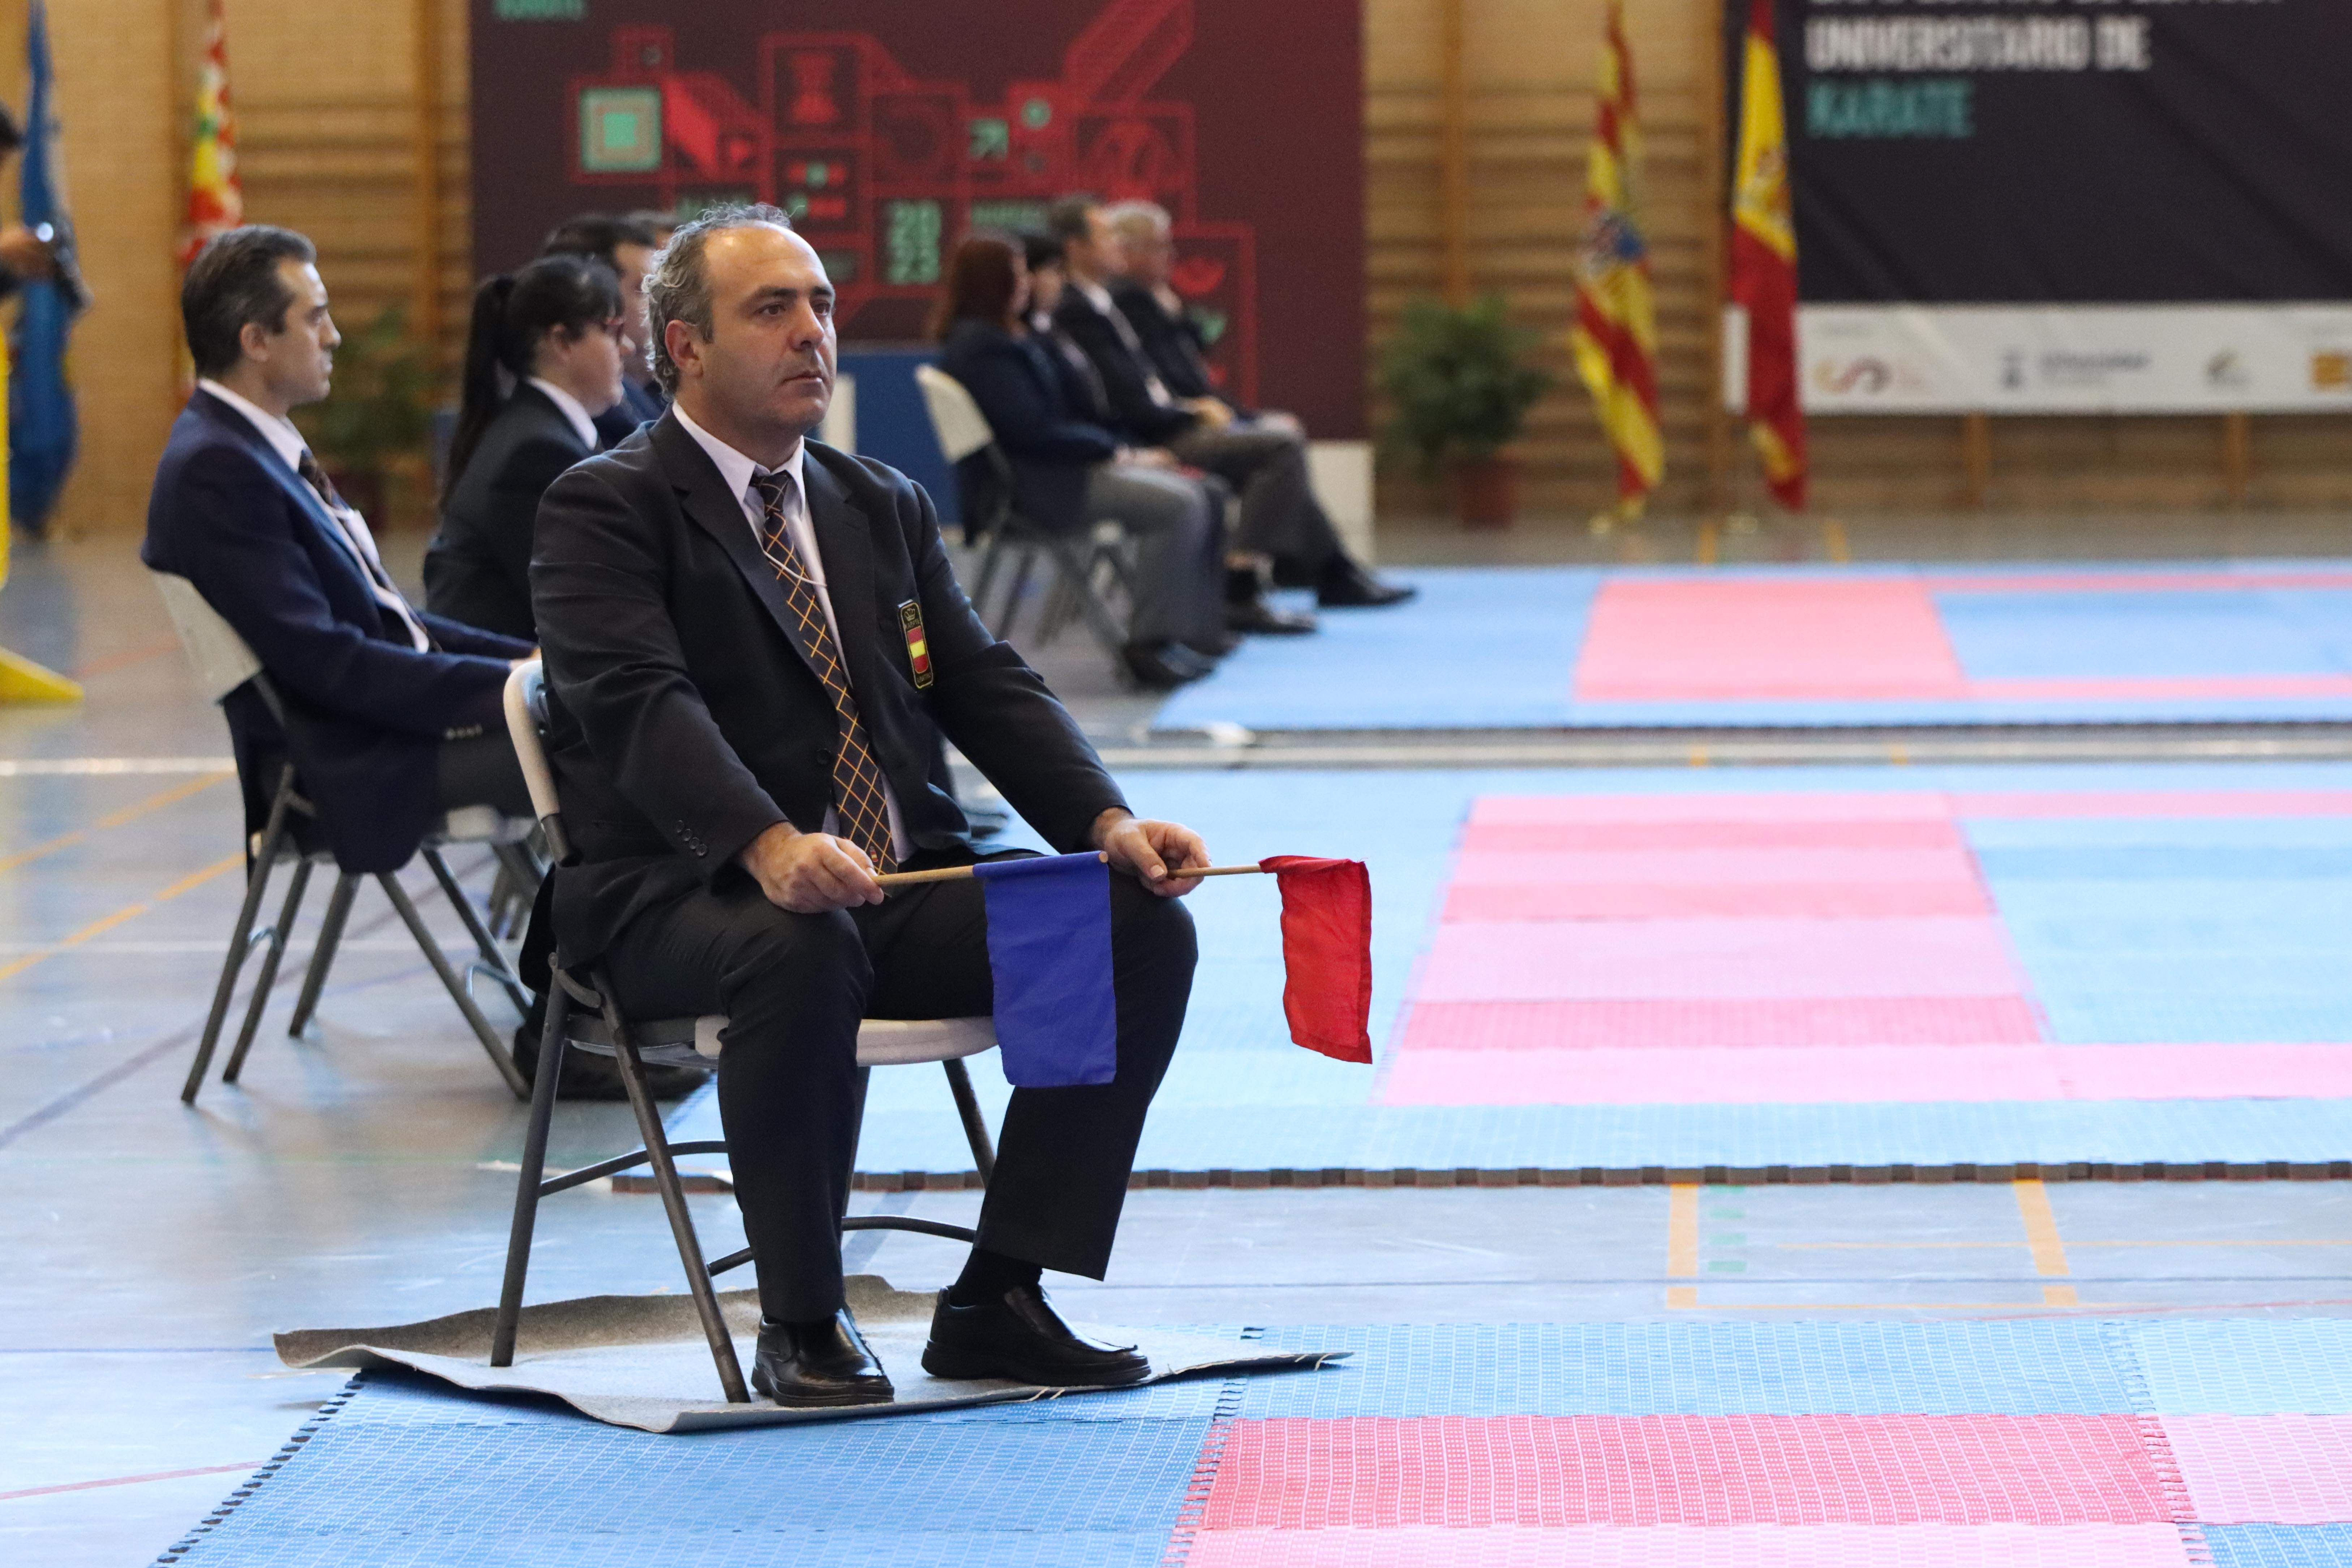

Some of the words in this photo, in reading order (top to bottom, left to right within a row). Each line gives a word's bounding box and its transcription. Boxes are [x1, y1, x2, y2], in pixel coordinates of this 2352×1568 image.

[1807, 17, 2090, 70] UNIVERSITARIO
[2095, 17, 2147, 70] DE
[1807, 80, 1969, 136] KARATE
